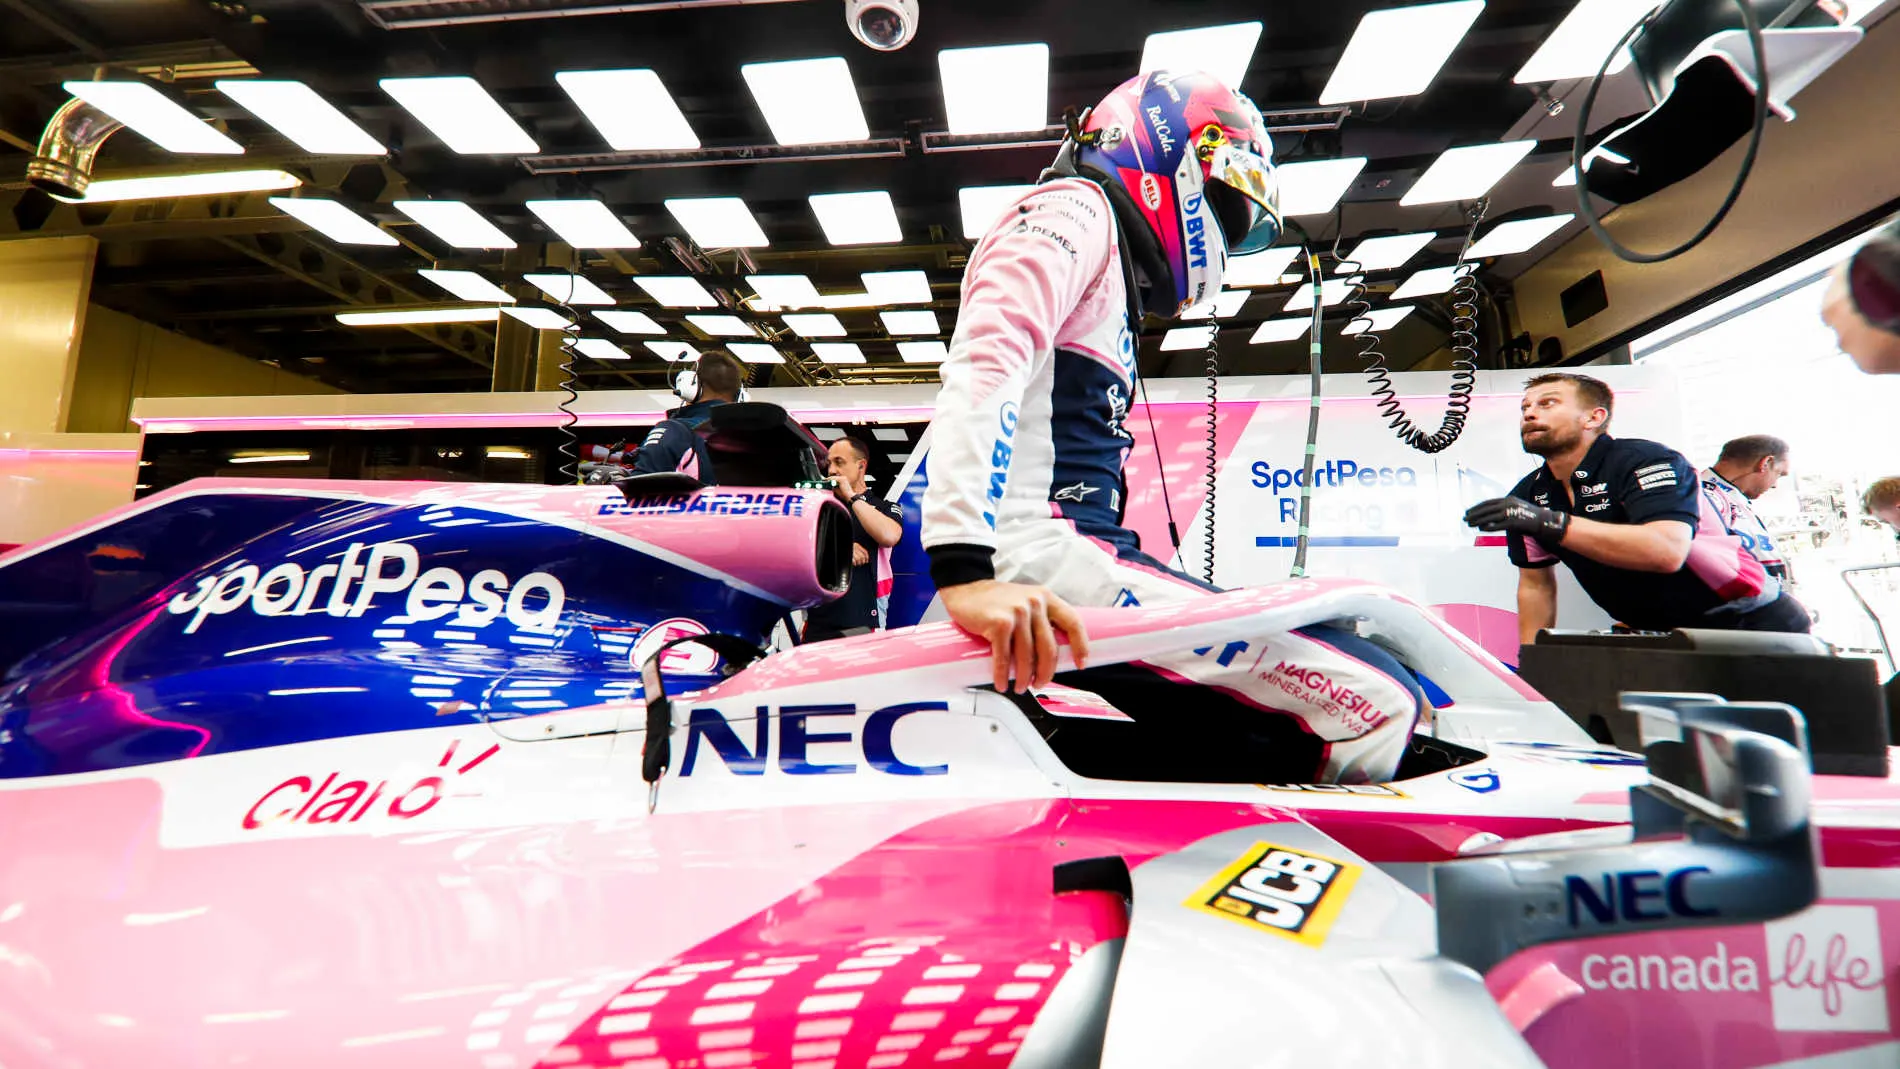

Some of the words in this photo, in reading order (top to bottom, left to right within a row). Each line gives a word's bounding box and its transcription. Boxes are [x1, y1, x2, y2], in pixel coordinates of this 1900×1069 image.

[1144, 178, 1158, 206] BELL
[1031, 225, 1077, 260] PEMEX
[1186, 215, 1207, 269] BWT
[597, 493, 805, 517] BOMBARDIER
[1279, 497, 1384, 531] Rcing
[168, 541, 566, 635] SportPesa
[678, 701, 949, 777] NEC
[1341, 712, 1366, 735] WA
[242, 767, 449, 831] Claro
[1227, 849, 1337, 930] JCB
[1565, 866, 1721, 929] NEC
[1581, 942, 1760, 993] canada
[1770, 932, 1887, 1018] life
